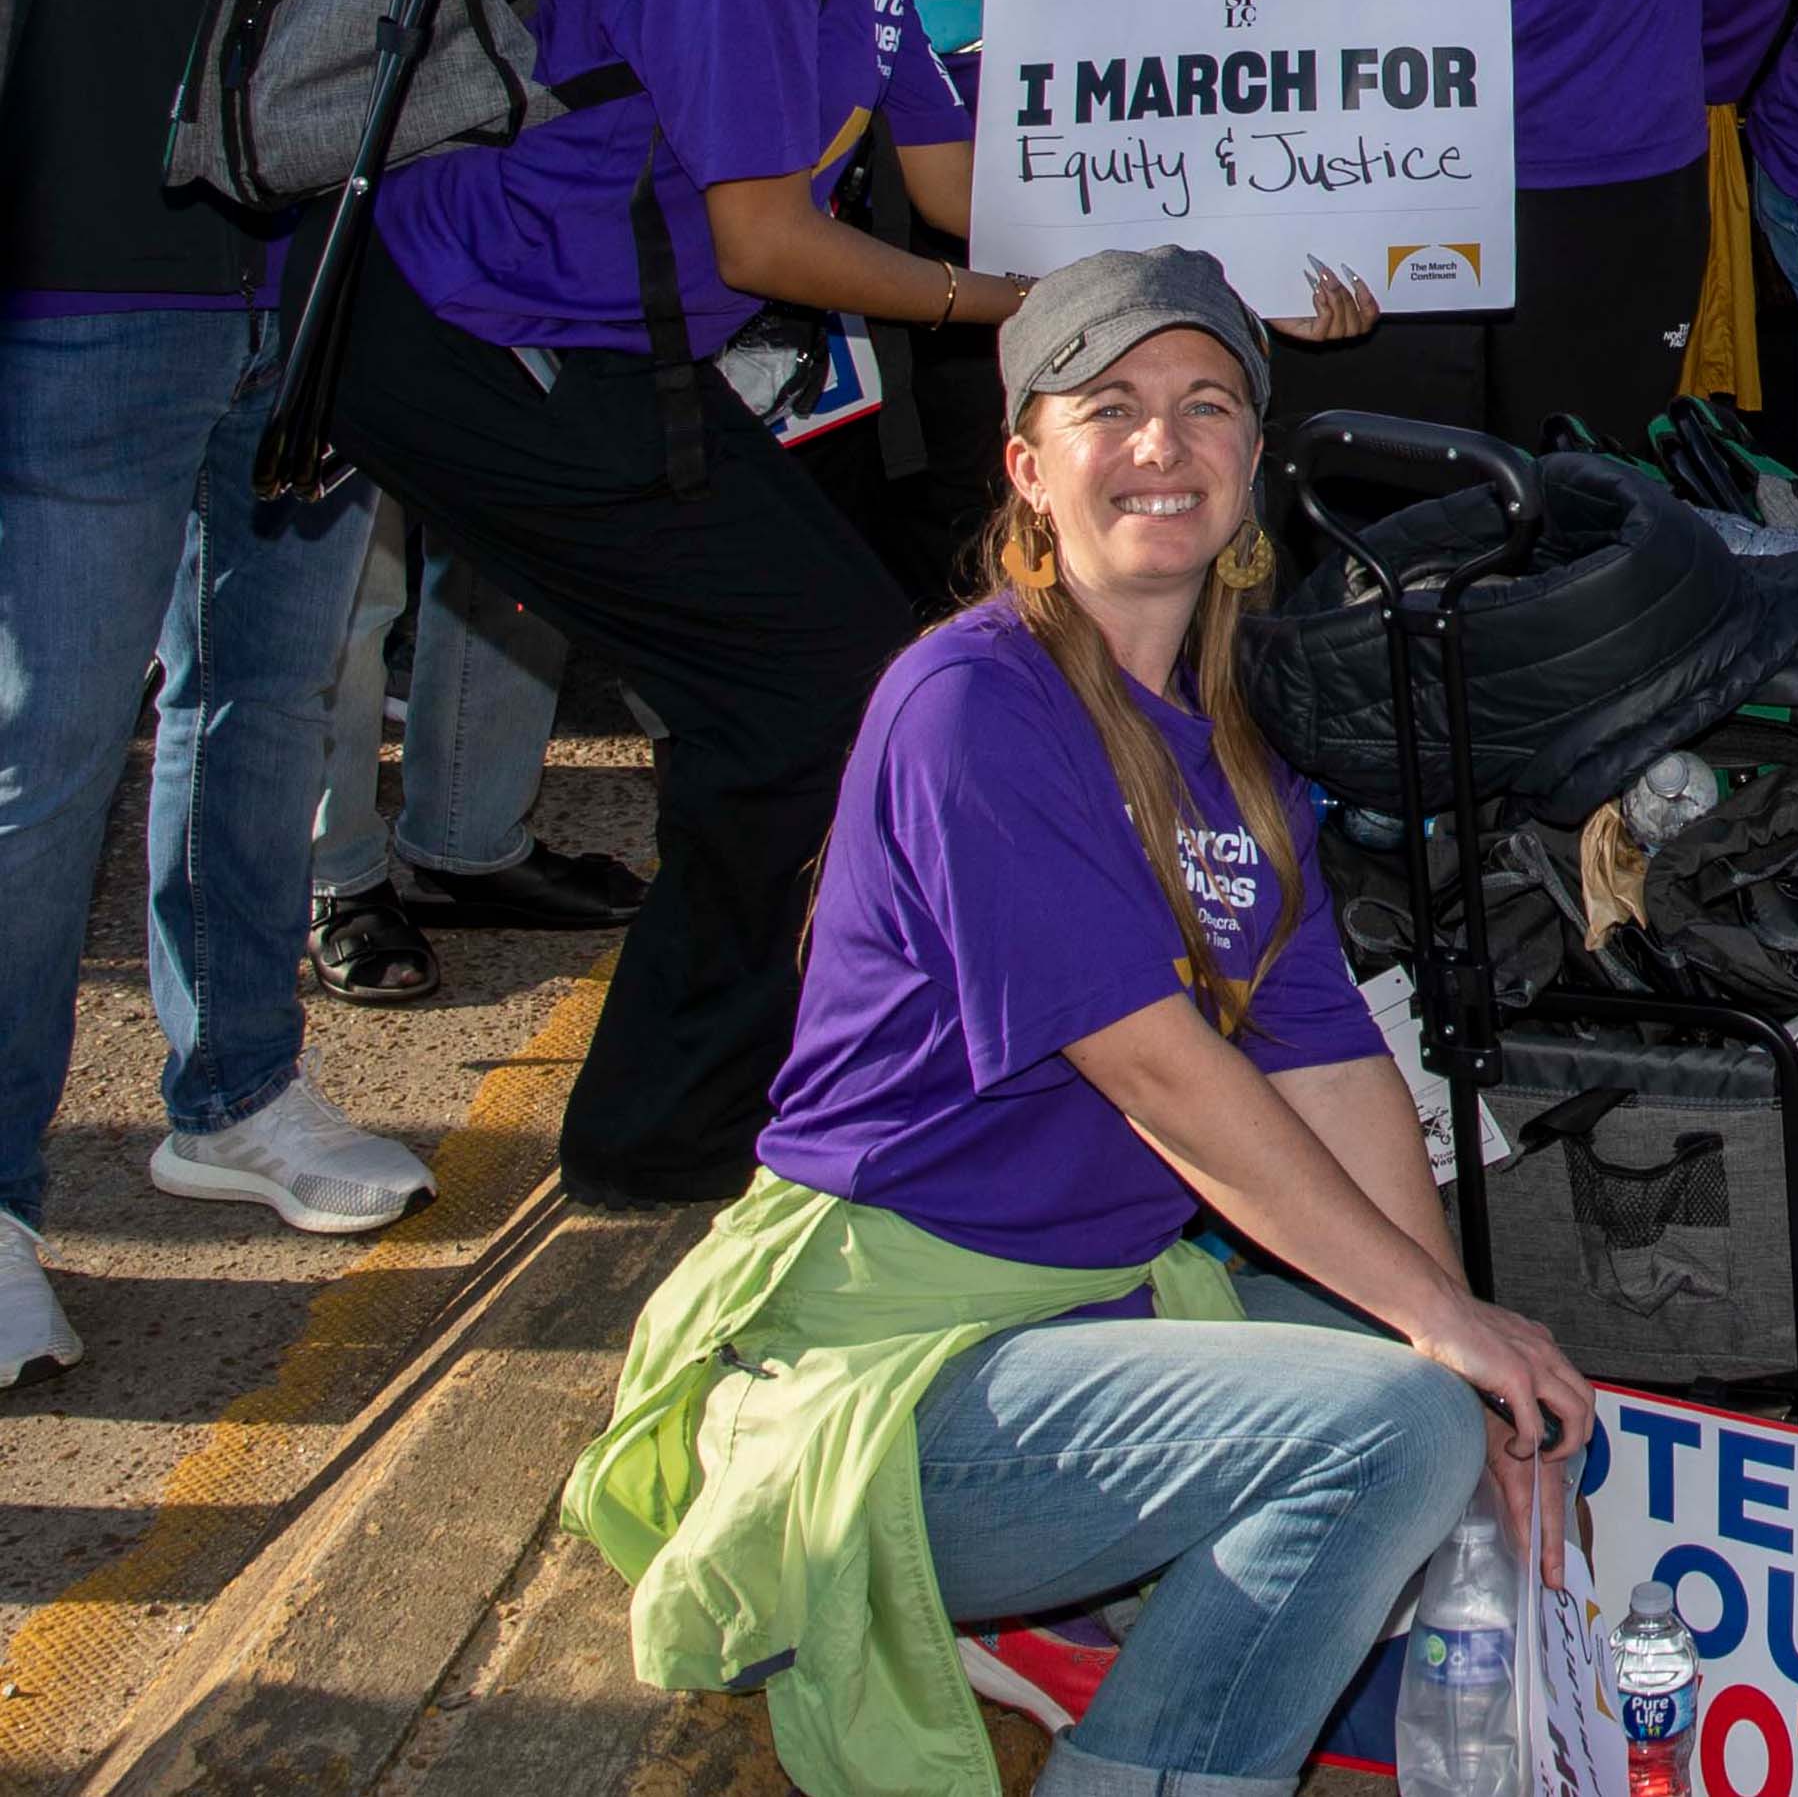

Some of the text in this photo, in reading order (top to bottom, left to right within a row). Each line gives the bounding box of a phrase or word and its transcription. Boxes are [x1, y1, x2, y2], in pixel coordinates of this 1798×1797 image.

[1017, 62, 1054, 127] I
[1075, 49, 1318, 124] MARCH
[1340, 46, 1478, 111] FOR
[1016, 133, 1191, 217] Equity
[1247, 131, 1473, 192] Justice
[1428, 261, 1457, 271] March
[1410, 271, 1457, 281] Continues
[1631, 1696, 1670, 1712] Pure
[1635, 1709, 1666, 1725] Life
